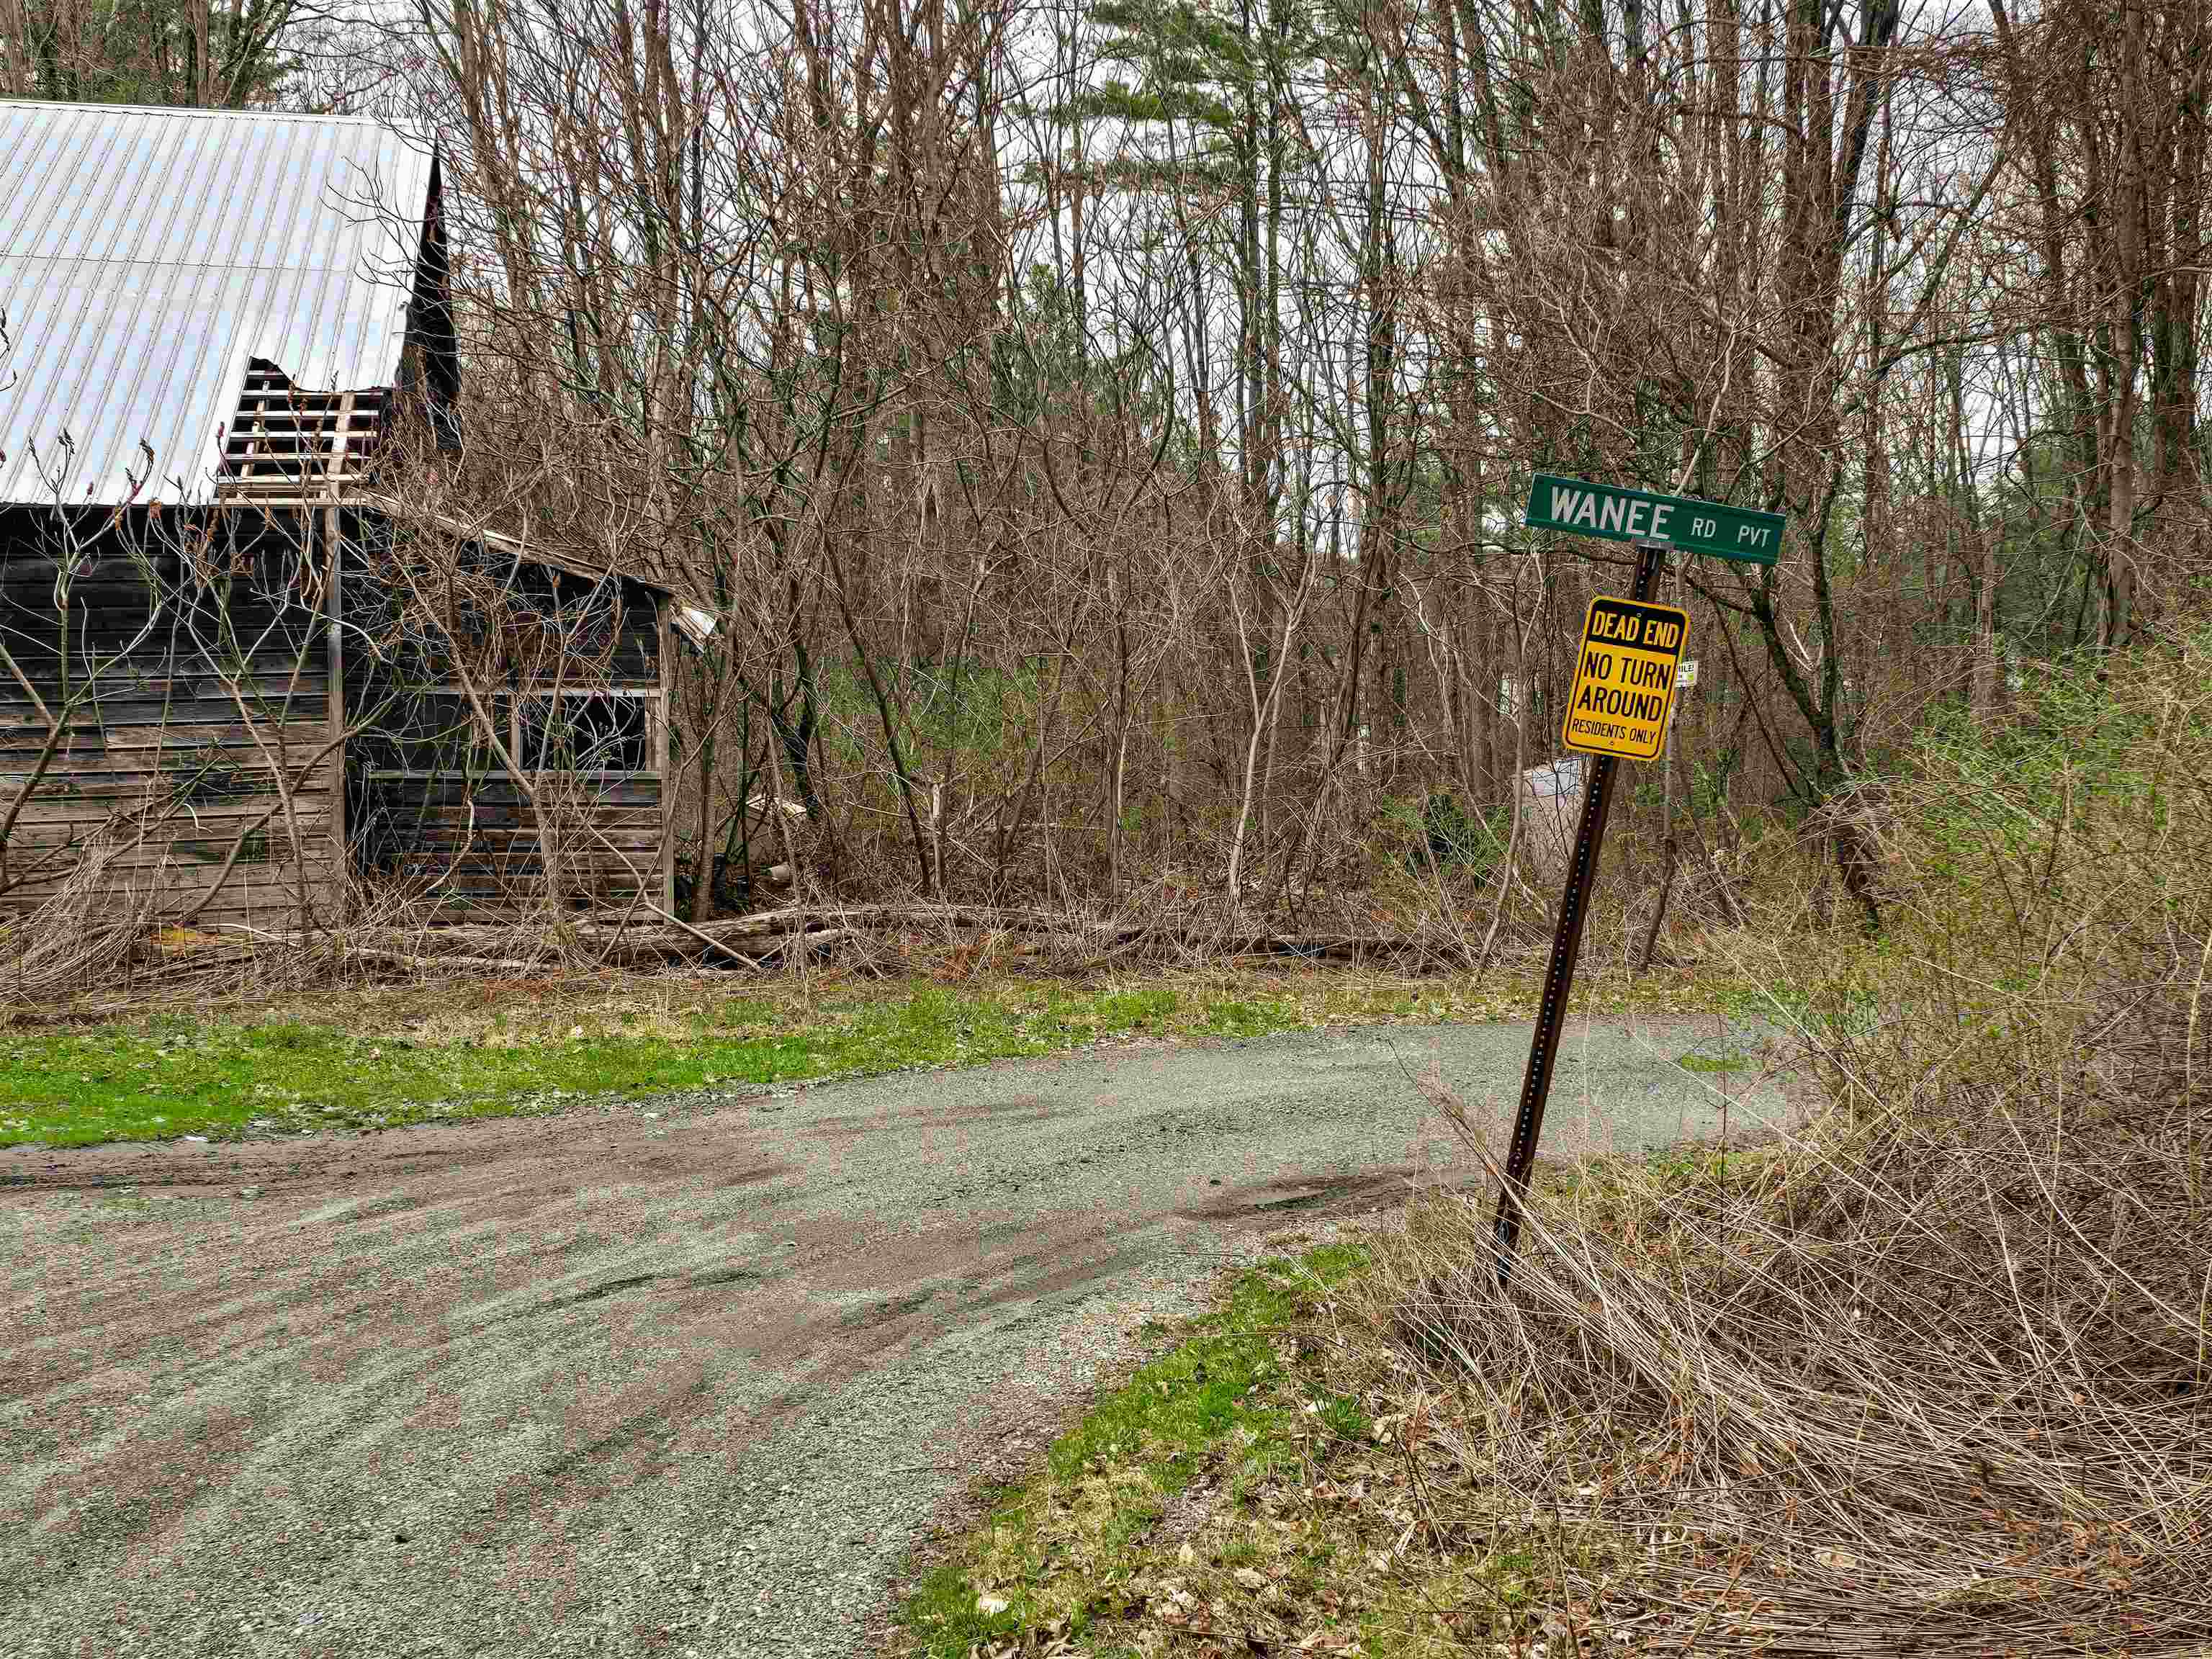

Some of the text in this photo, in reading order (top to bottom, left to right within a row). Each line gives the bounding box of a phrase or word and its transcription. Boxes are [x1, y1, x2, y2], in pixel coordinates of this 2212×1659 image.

[1551, 486, 1771, 547] WANEE RD PVT
[1592, 611, 1679, 648] DEAD END
[1584, 651, 1671, 691] NO TURN
[1578, 685, 1663, 721] AROUND
[1572, 719, 1656, 745] RESIDENTS ONLY
